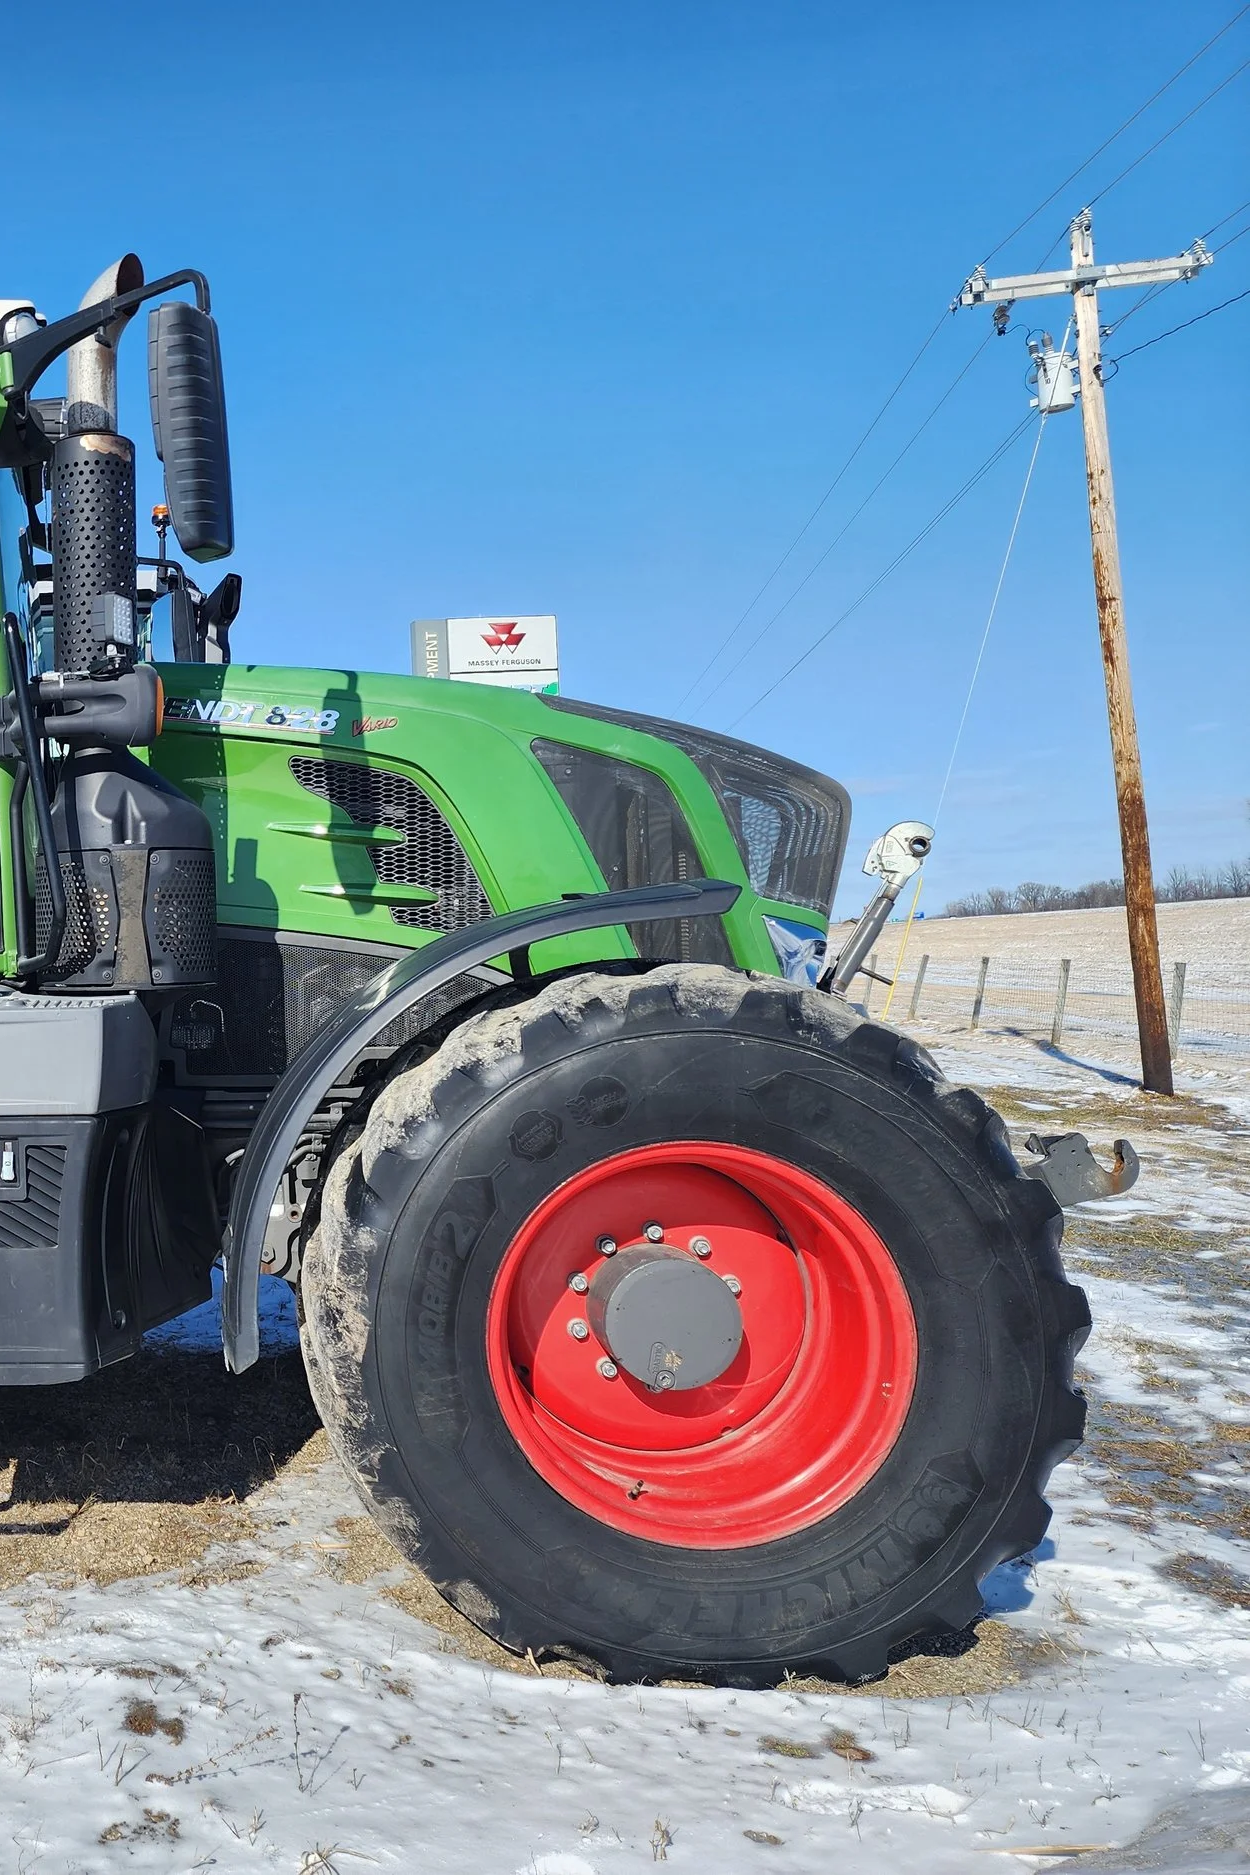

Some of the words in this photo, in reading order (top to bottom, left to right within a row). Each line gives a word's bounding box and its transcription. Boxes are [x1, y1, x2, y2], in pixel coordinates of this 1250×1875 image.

[502, 658, 541, 666] FERGUSON
[165, 697, 264, 724] ENDT
[266, 705, 340, 730] 828
[575, 1536, 908, 1641] MICHEL
